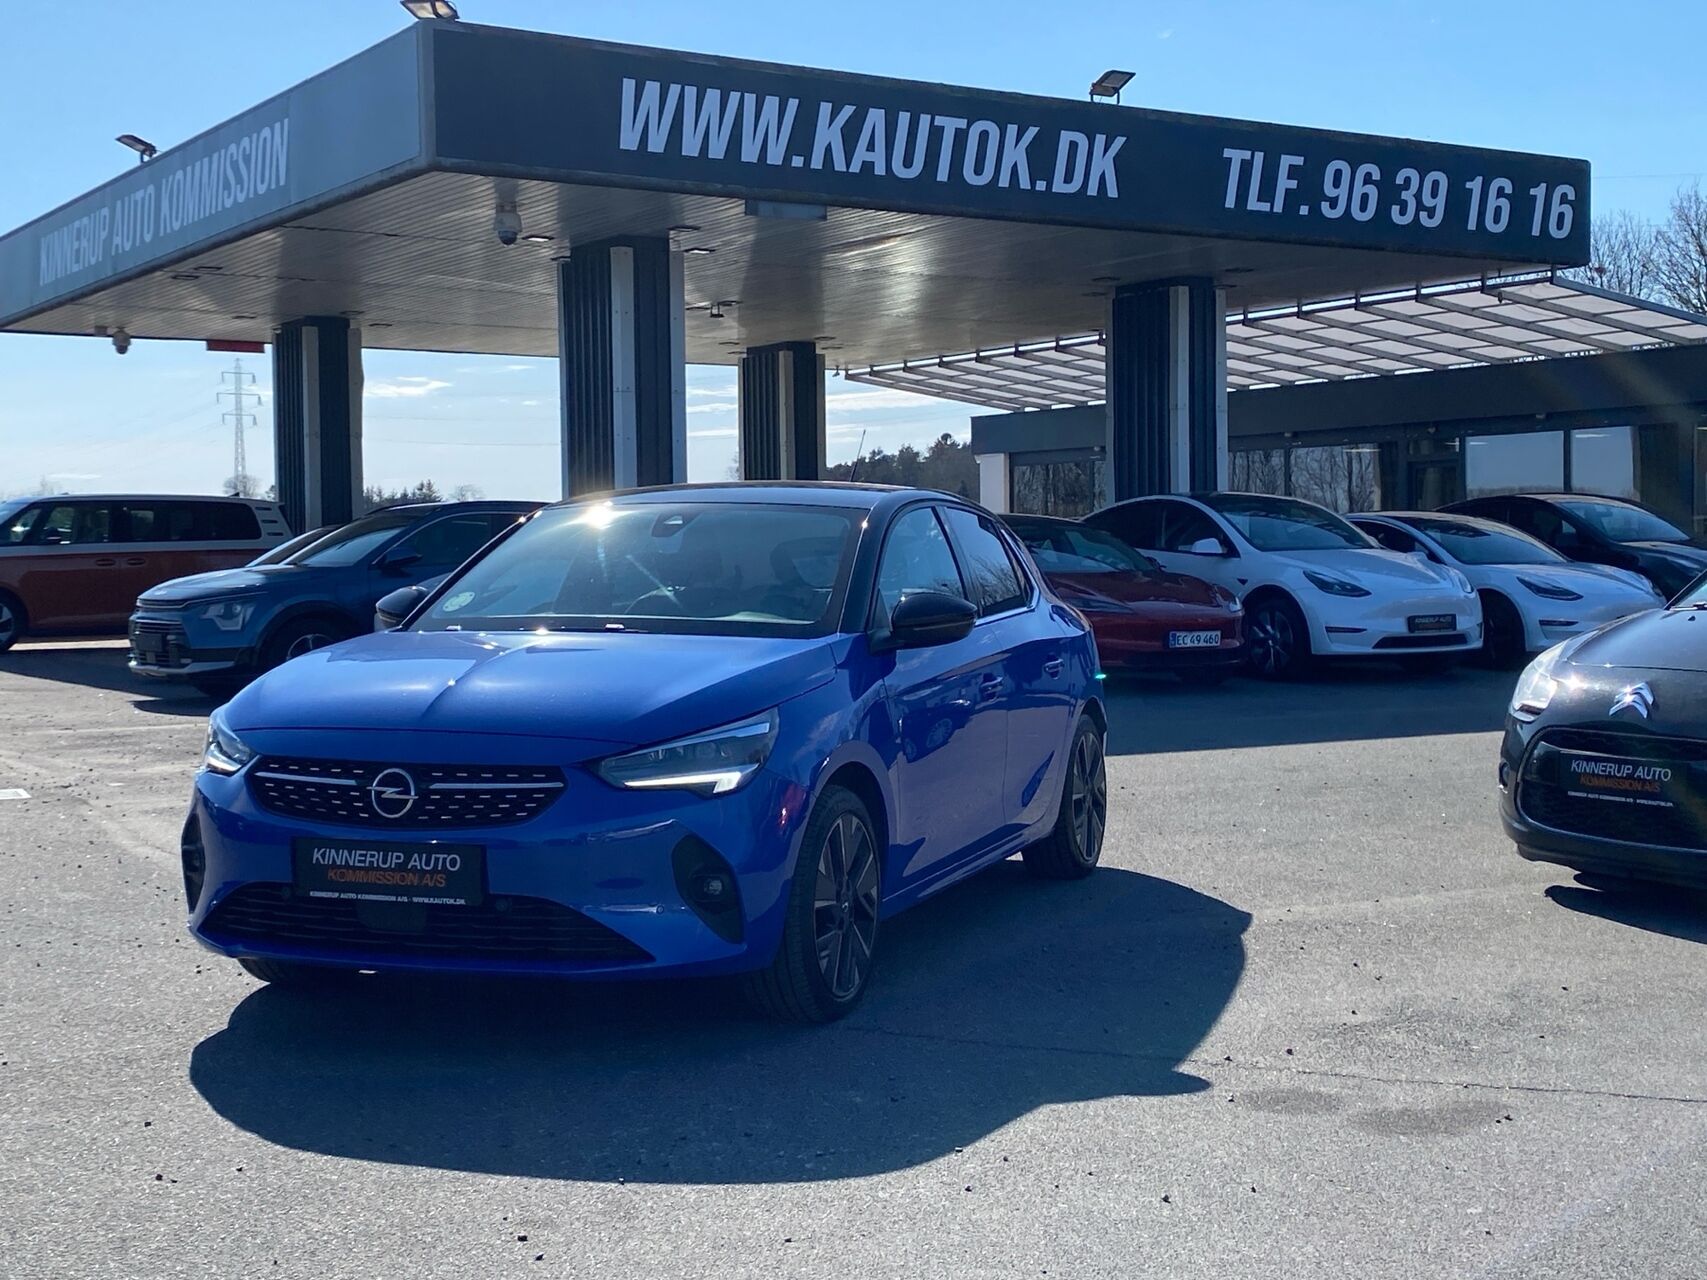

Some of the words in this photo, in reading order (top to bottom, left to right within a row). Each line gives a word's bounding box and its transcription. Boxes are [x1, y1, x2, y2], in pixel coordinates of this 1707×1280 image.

[619, 77, 1127, 199] WWW.KAUTOK.DK
[39, 207, 109, 286] KINNERUP
[111, 184, 155, 256] AUTO
[159, 118, 289, 237] KOMMISSION
[1222, 147, 1308, 215] TLF.
[1320, 159, 1381, 222] 96
[1391, 168, 1448, 229] 39
[1464, 175, 1513, 234] 16
[1528, 182, 1576, 240] 16
[1190, 634, 1201, 645] 49
[1570, 759, 1633, 777] KINNERUP
[1634, 766, 1672, 782] AUTO
[312, 847, 404, 869] KINNERUP
[407, 853, 461, 872] AUTO
[327, 868, 418, 886] KOMMISSION
[421, 872, 447, 888] A/S
